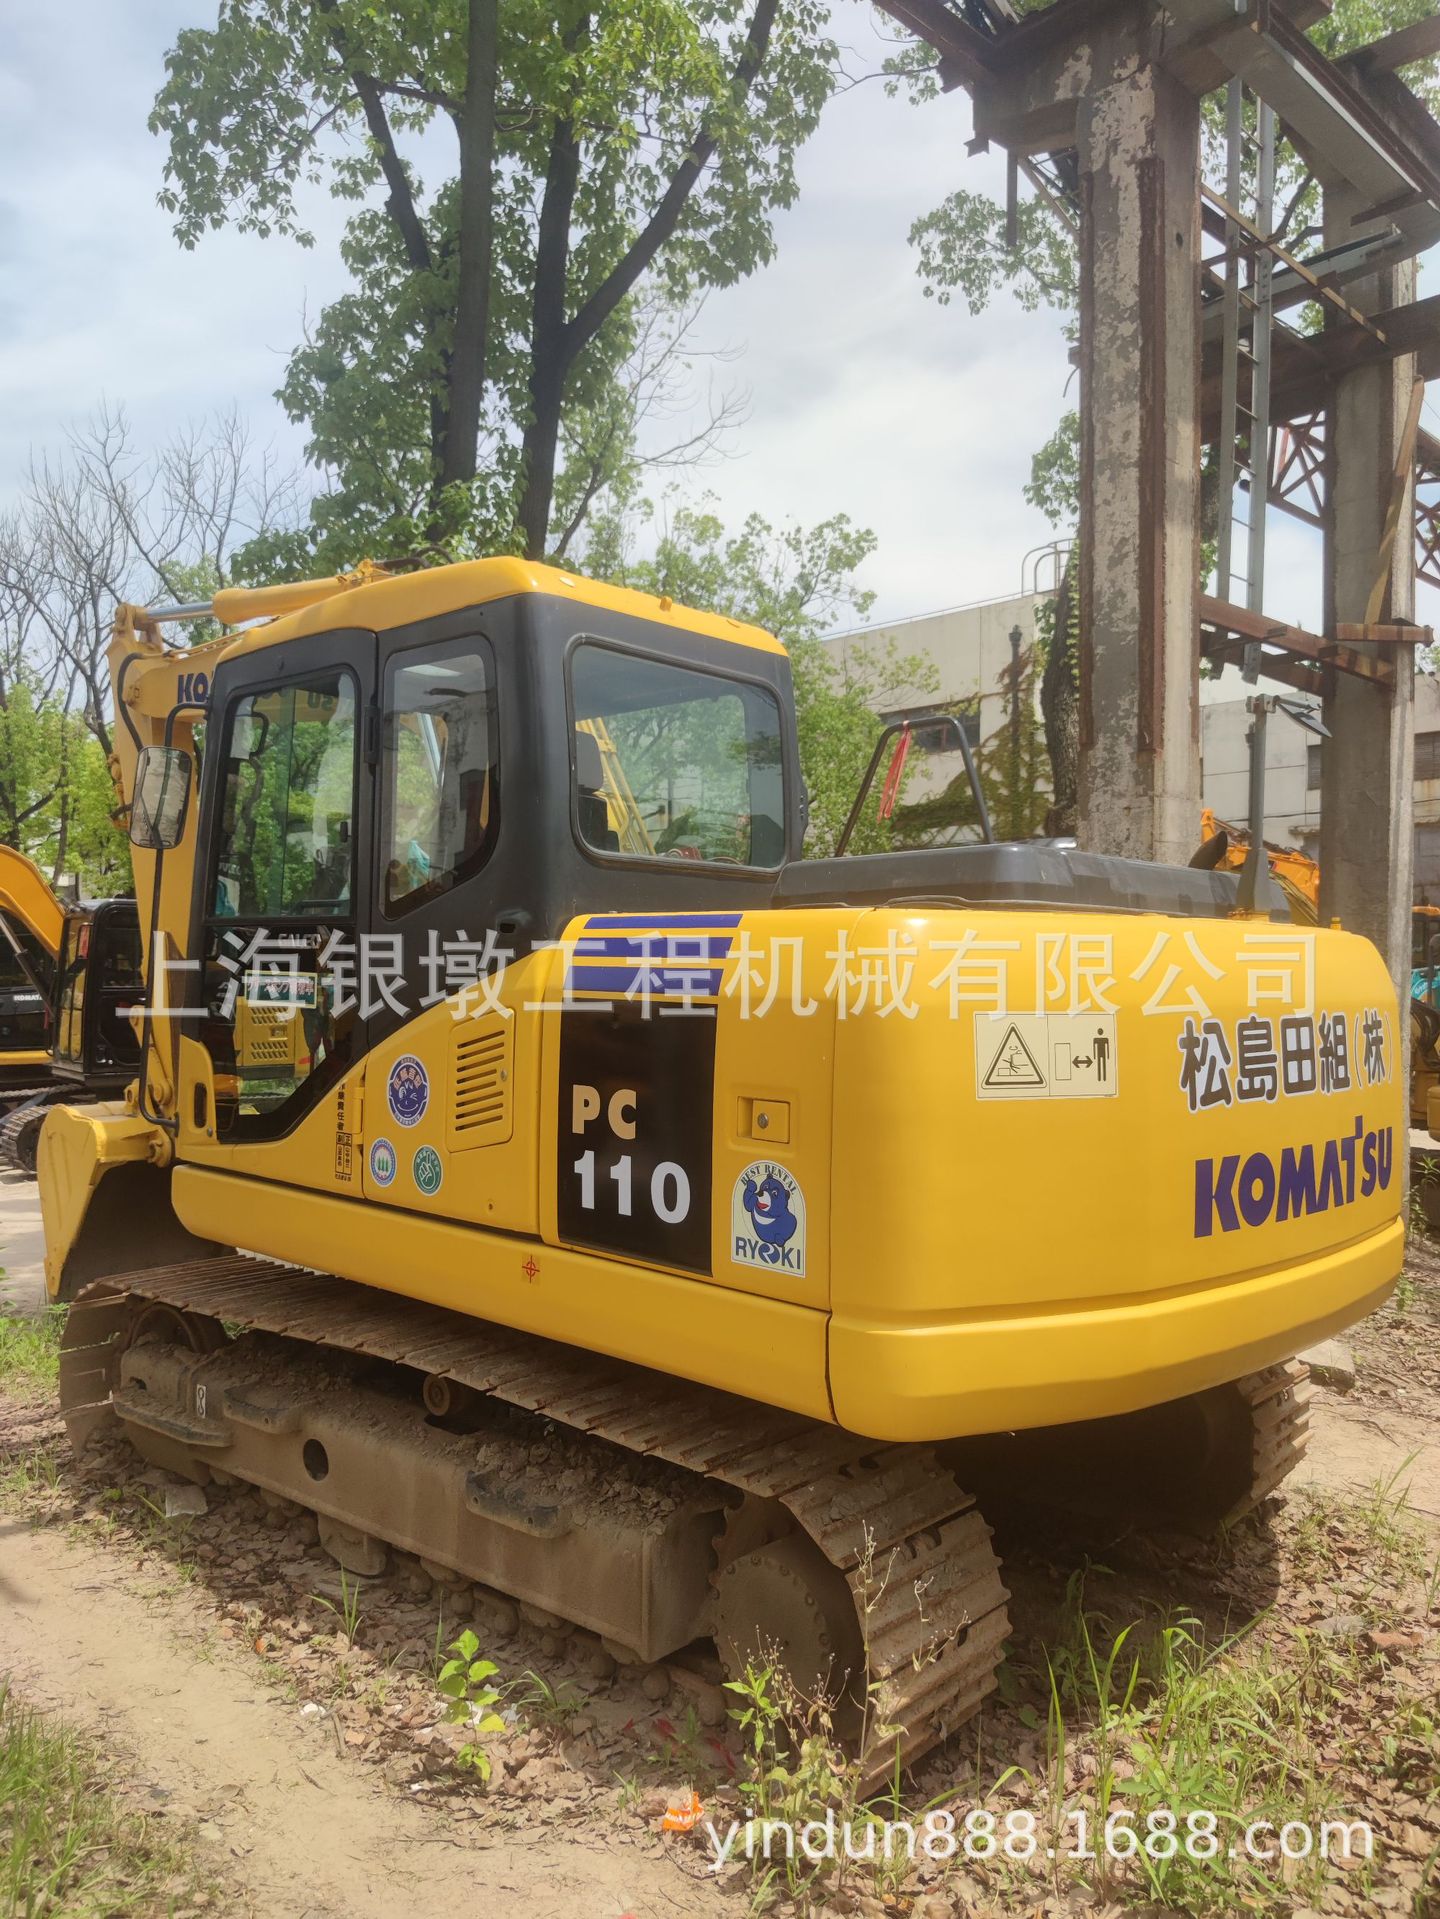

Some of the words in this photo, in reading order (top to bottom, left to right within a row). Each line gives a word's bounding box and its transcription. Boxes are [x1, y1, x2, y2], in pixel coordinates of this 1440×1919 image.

[177, 671, 213, 704] KO
[572, 1084, 637, 1140] PC
[573, 1150, 691, 1224] 110
[740, 1165, 761, 1186] BEST
[764, 1164, 798, 1195] RENTAL
[1194, 1115, 1393, 1238] KOMATSU
